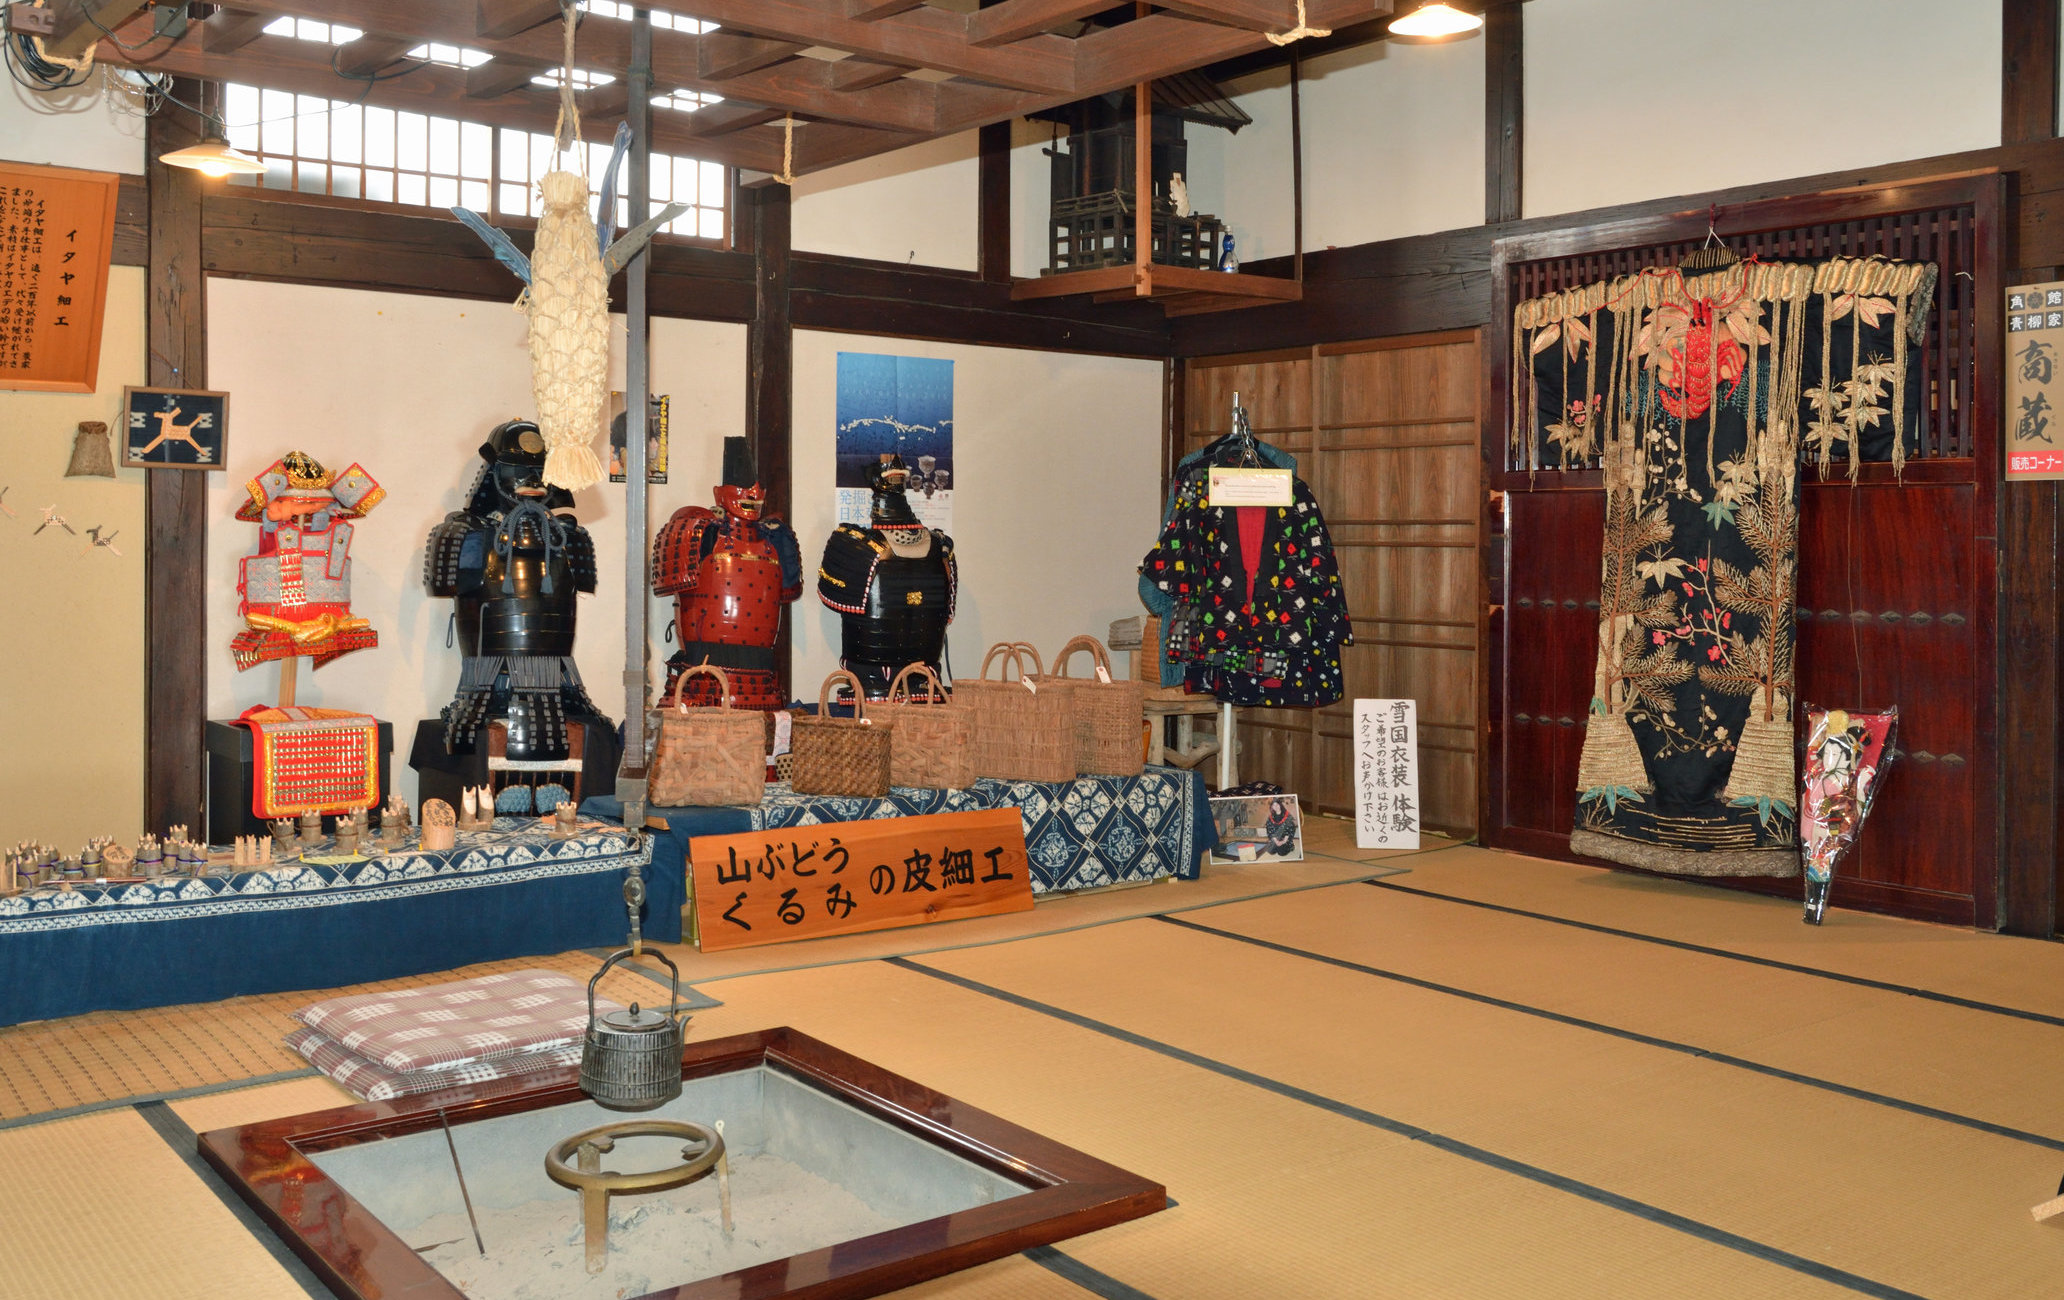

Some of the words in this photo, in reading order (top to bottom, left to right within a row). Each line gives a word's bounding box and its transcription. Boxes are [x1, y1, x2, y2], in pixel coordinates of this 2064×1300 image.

[54, 229, 78, 327] イタヤ細工
[2010, 291, 2062, 310] 角館
[2010, 312, 2062, 331] 青柳家
[2010, 455, 2062, 471] 販売コーナー
[717, 837, 850, 886] 山ぶどう
[869, 846, 1015, 896] の皮細工
[722, 883, 858, 932] くるみ
